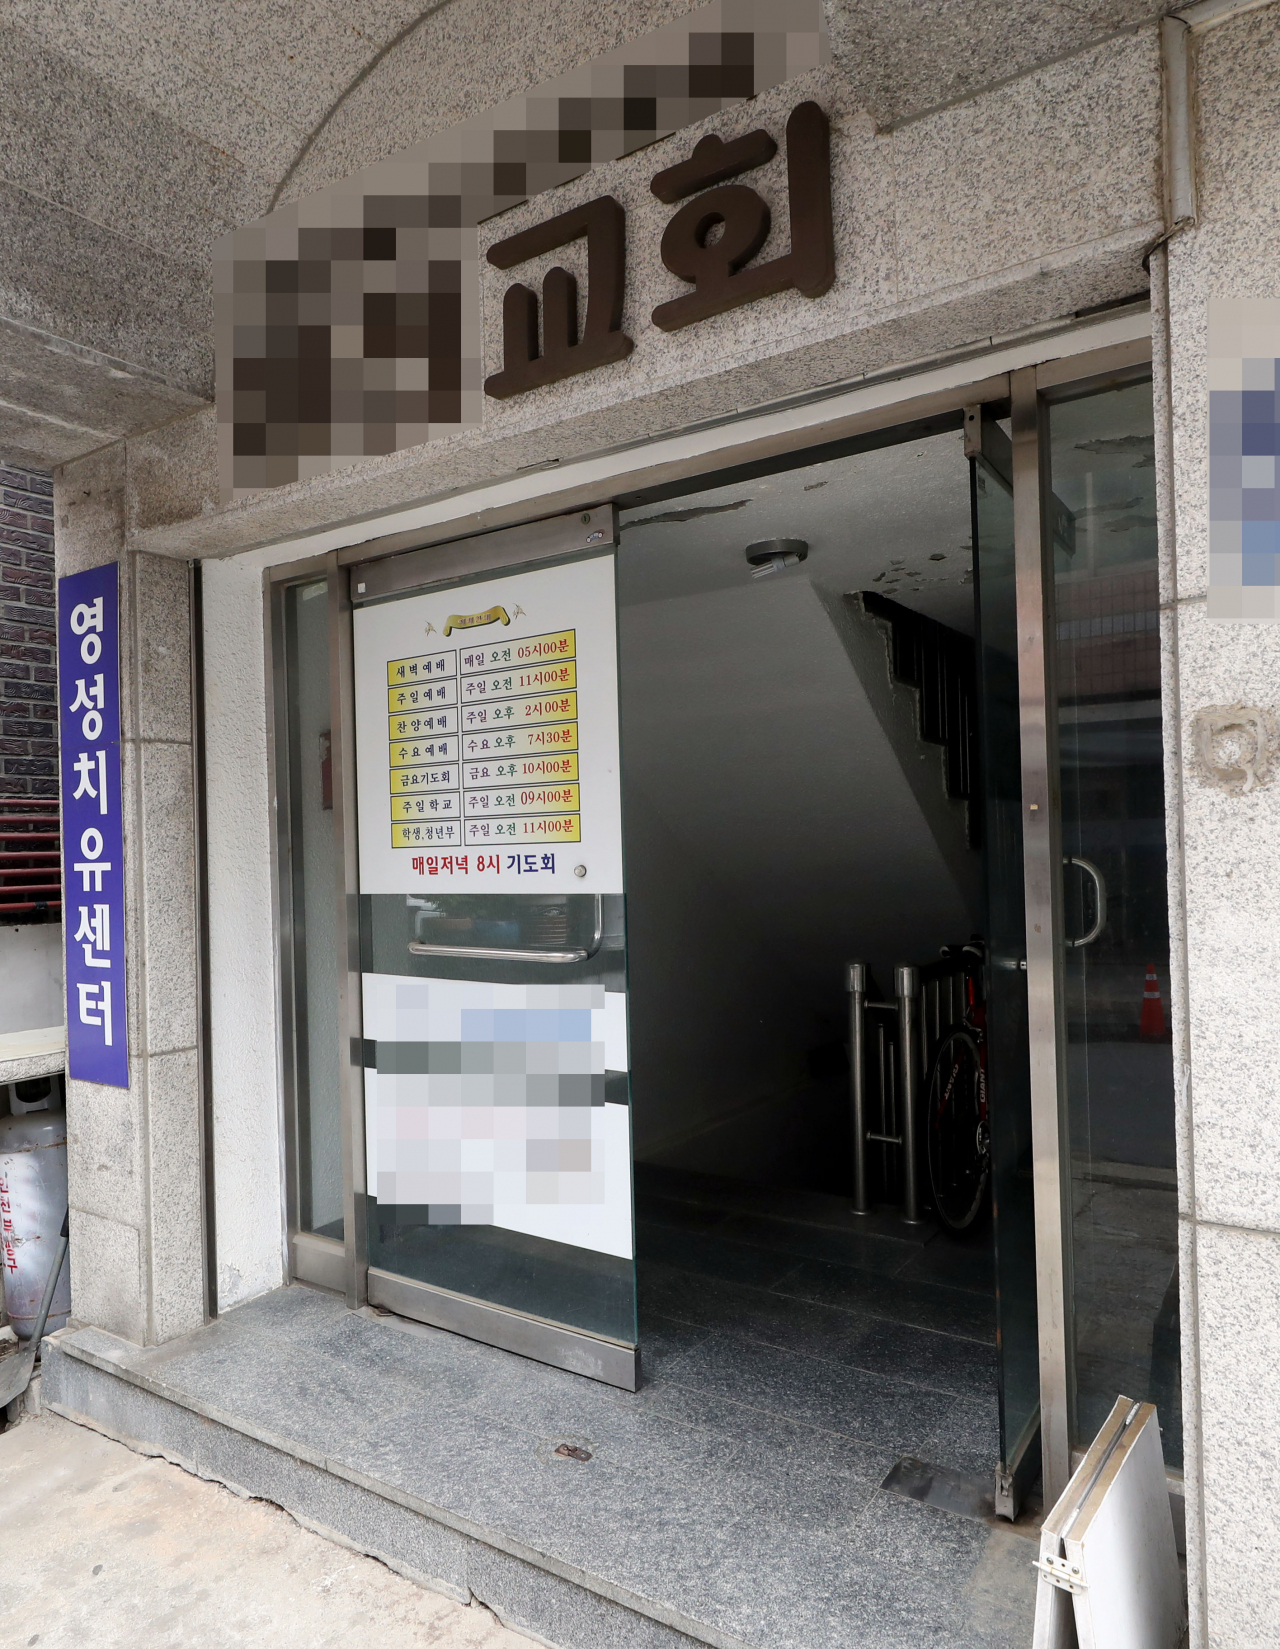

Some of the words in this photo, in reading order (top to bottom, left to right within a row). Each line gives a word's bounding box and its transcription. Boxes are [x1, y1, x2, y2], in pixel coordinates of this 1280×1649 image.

[485, 100, 836, 401] 교회
[464, 653, 484, 667] 매일
[490, 648, 511, 662] 오전
[517, 638, 570, 658] 05시00분
[466, 680, 486, 695] 주일
[491, 677, 512, 691] 오전
[518, 668, 570, 686] 11시00분
[466, 709, 487, 724] 주일
[493, 706, 514, 719] 오후
[524, 699, 570, 716] 2시00분
[468, 739, 490, 751] 수요
[494, 735, 515, 748] 오후
[528, 729, 572, 745] 7시30분
[470, 767, 490, 780] 금요
[496, 764, 517, 777] 오후
[523, 759, 572, 774] 10시00분
[469, 795, 489, 809] 주일
[494, 794, 515, 807] 오전
[521, 789, 573, 805] 09시00분
[69, 596, 113, 1047] 영성치유센터
[469, 823, 490, 837] 주일
[495, 823, 516, 835] 오전
[524, 819, 574, 834] 11시00분
[412, 855, 468, 875] 매일저녁
[477, 854, 500, 874] 8시
[507, 853, 555, 874] 기도회
